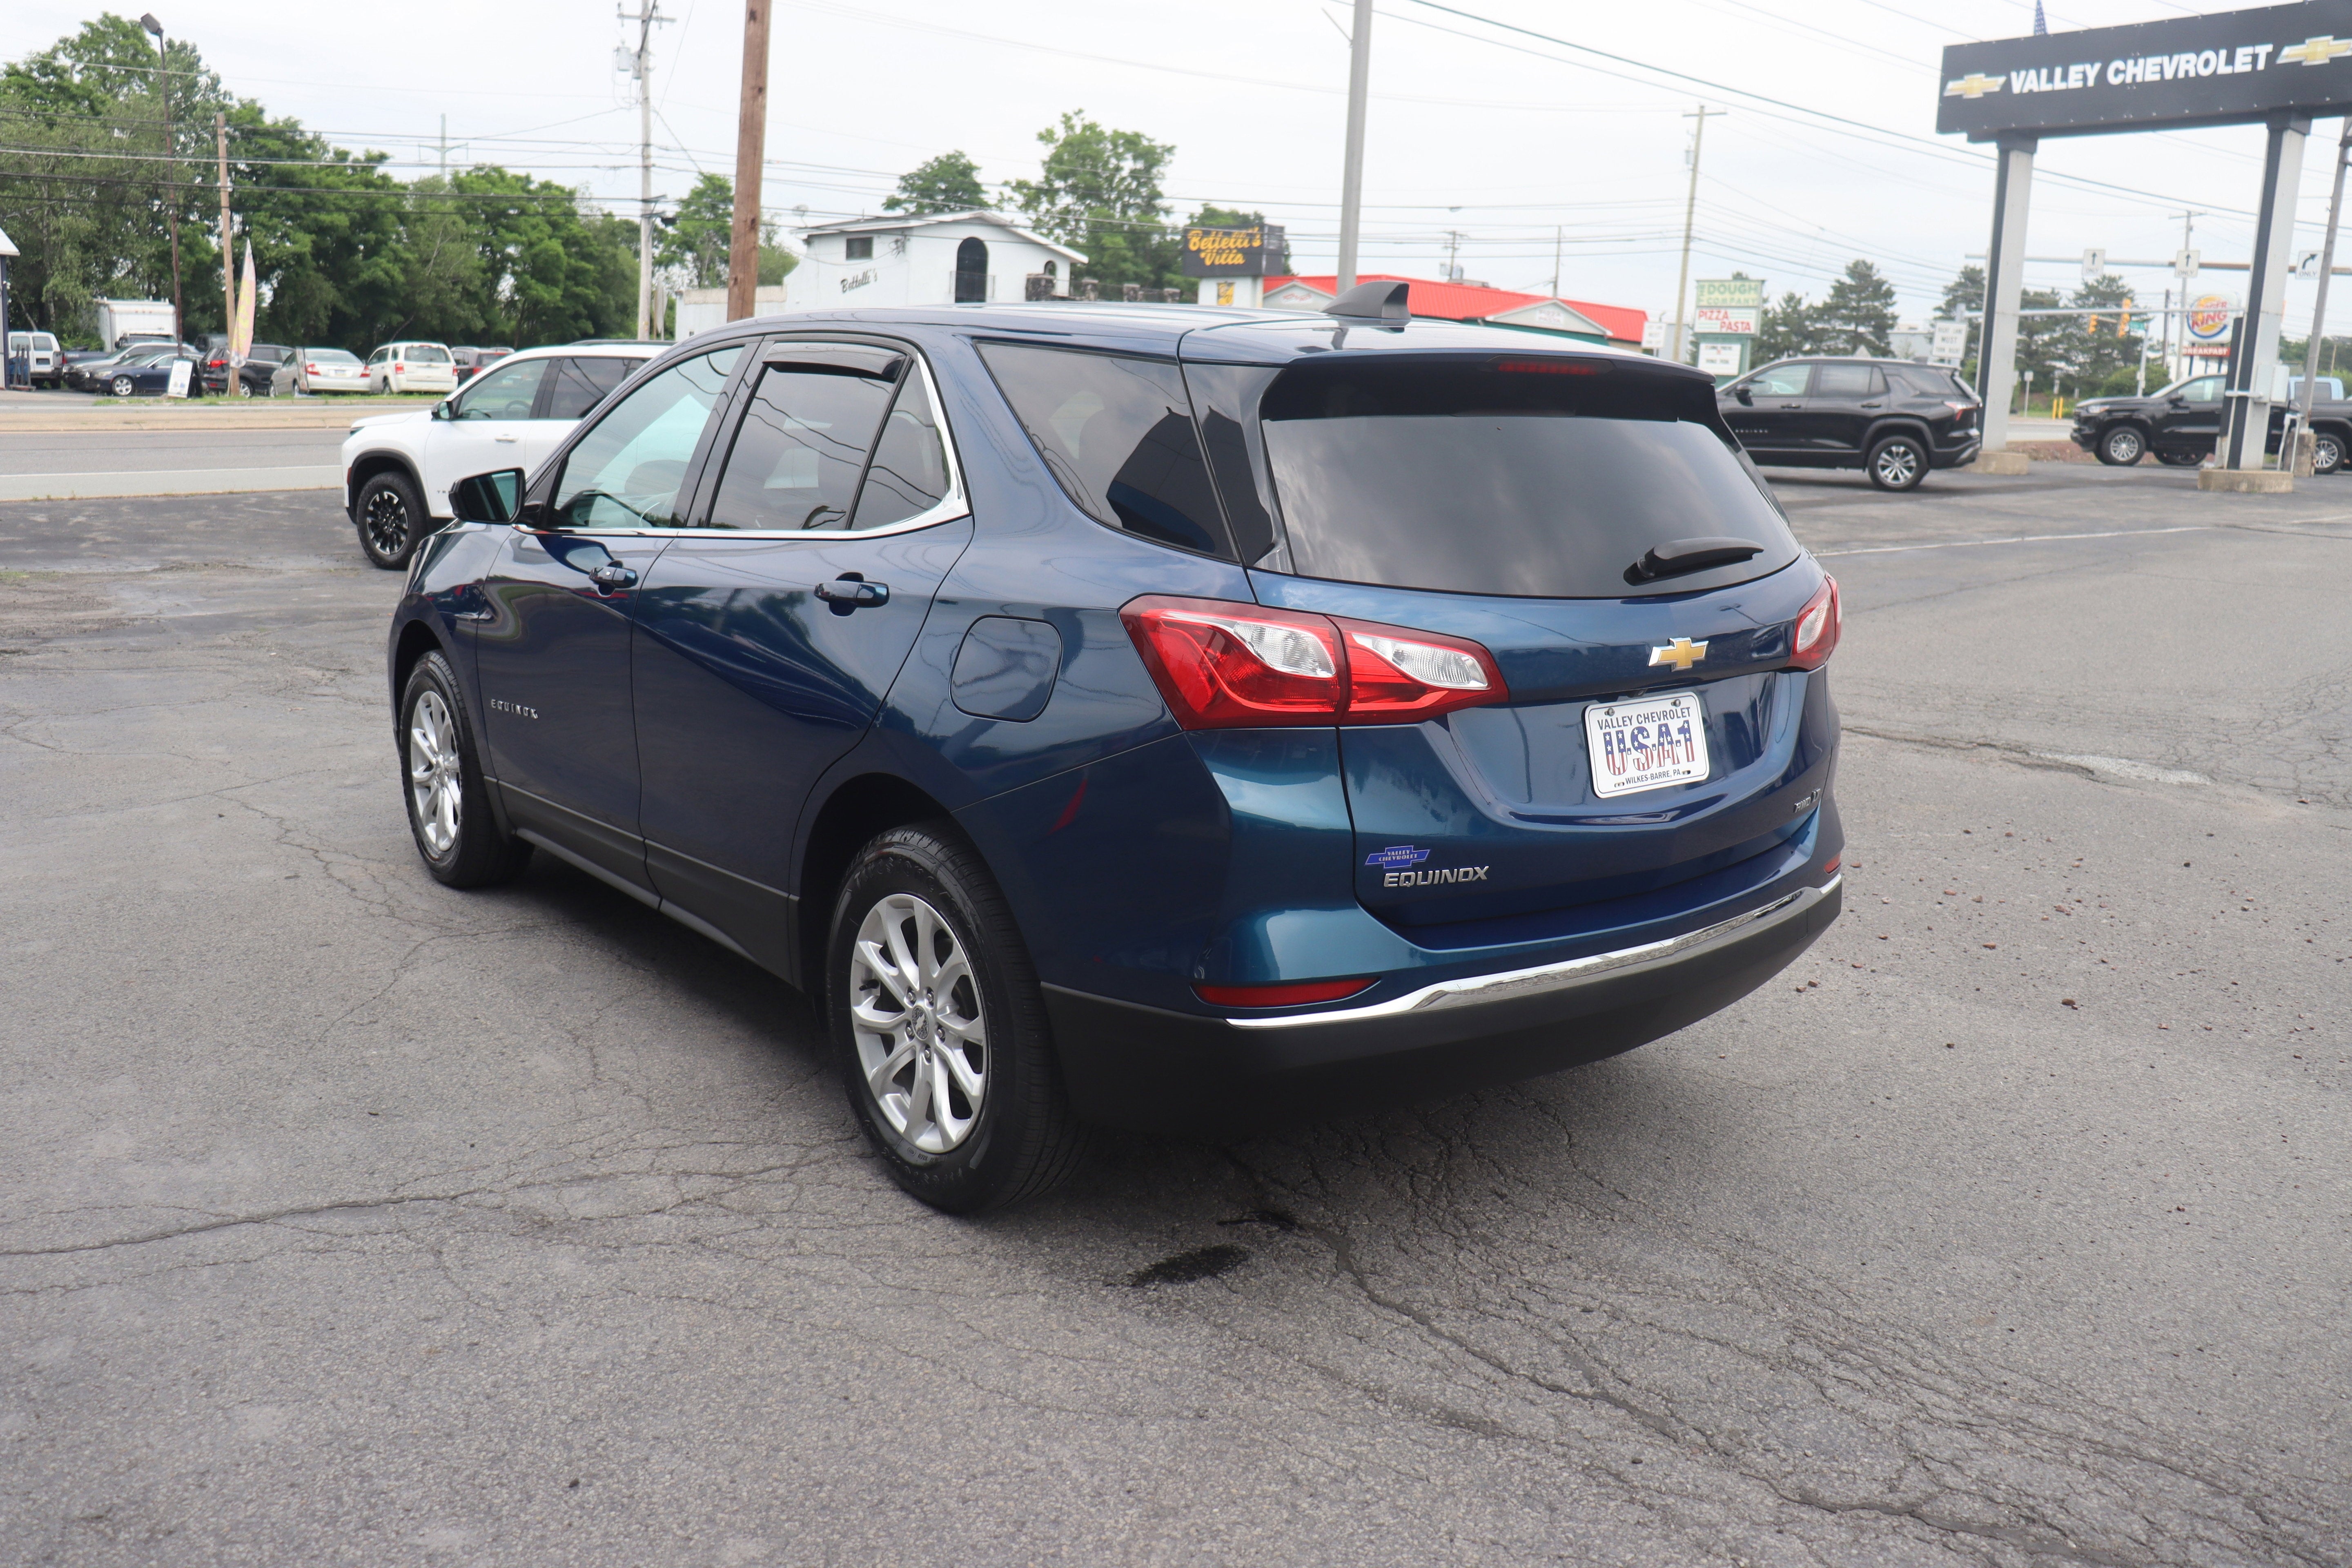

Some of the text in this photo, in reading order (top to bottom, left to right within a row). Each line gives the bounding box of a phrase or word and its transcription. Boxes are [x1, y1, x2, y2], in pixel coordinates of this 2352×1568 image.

[2010, 43, 2273, 95] VALLEY CHEVROLET
[1199, 249, 1245, 266] Villa
[1707, 283, 1758, 294] DOUGH
[1698, 310, 1729, 321] PIZZA
[1719, 321, 1751, 332] PASTA
[491, 699, 539, 719] EQUINOX
[1597, 706, 1691, 731] VALLEY CHEVROLET
[1625, 771, 1672, 785] WILKES-BARRE,
[1383, 866, 1489, 887] EQUINOX
